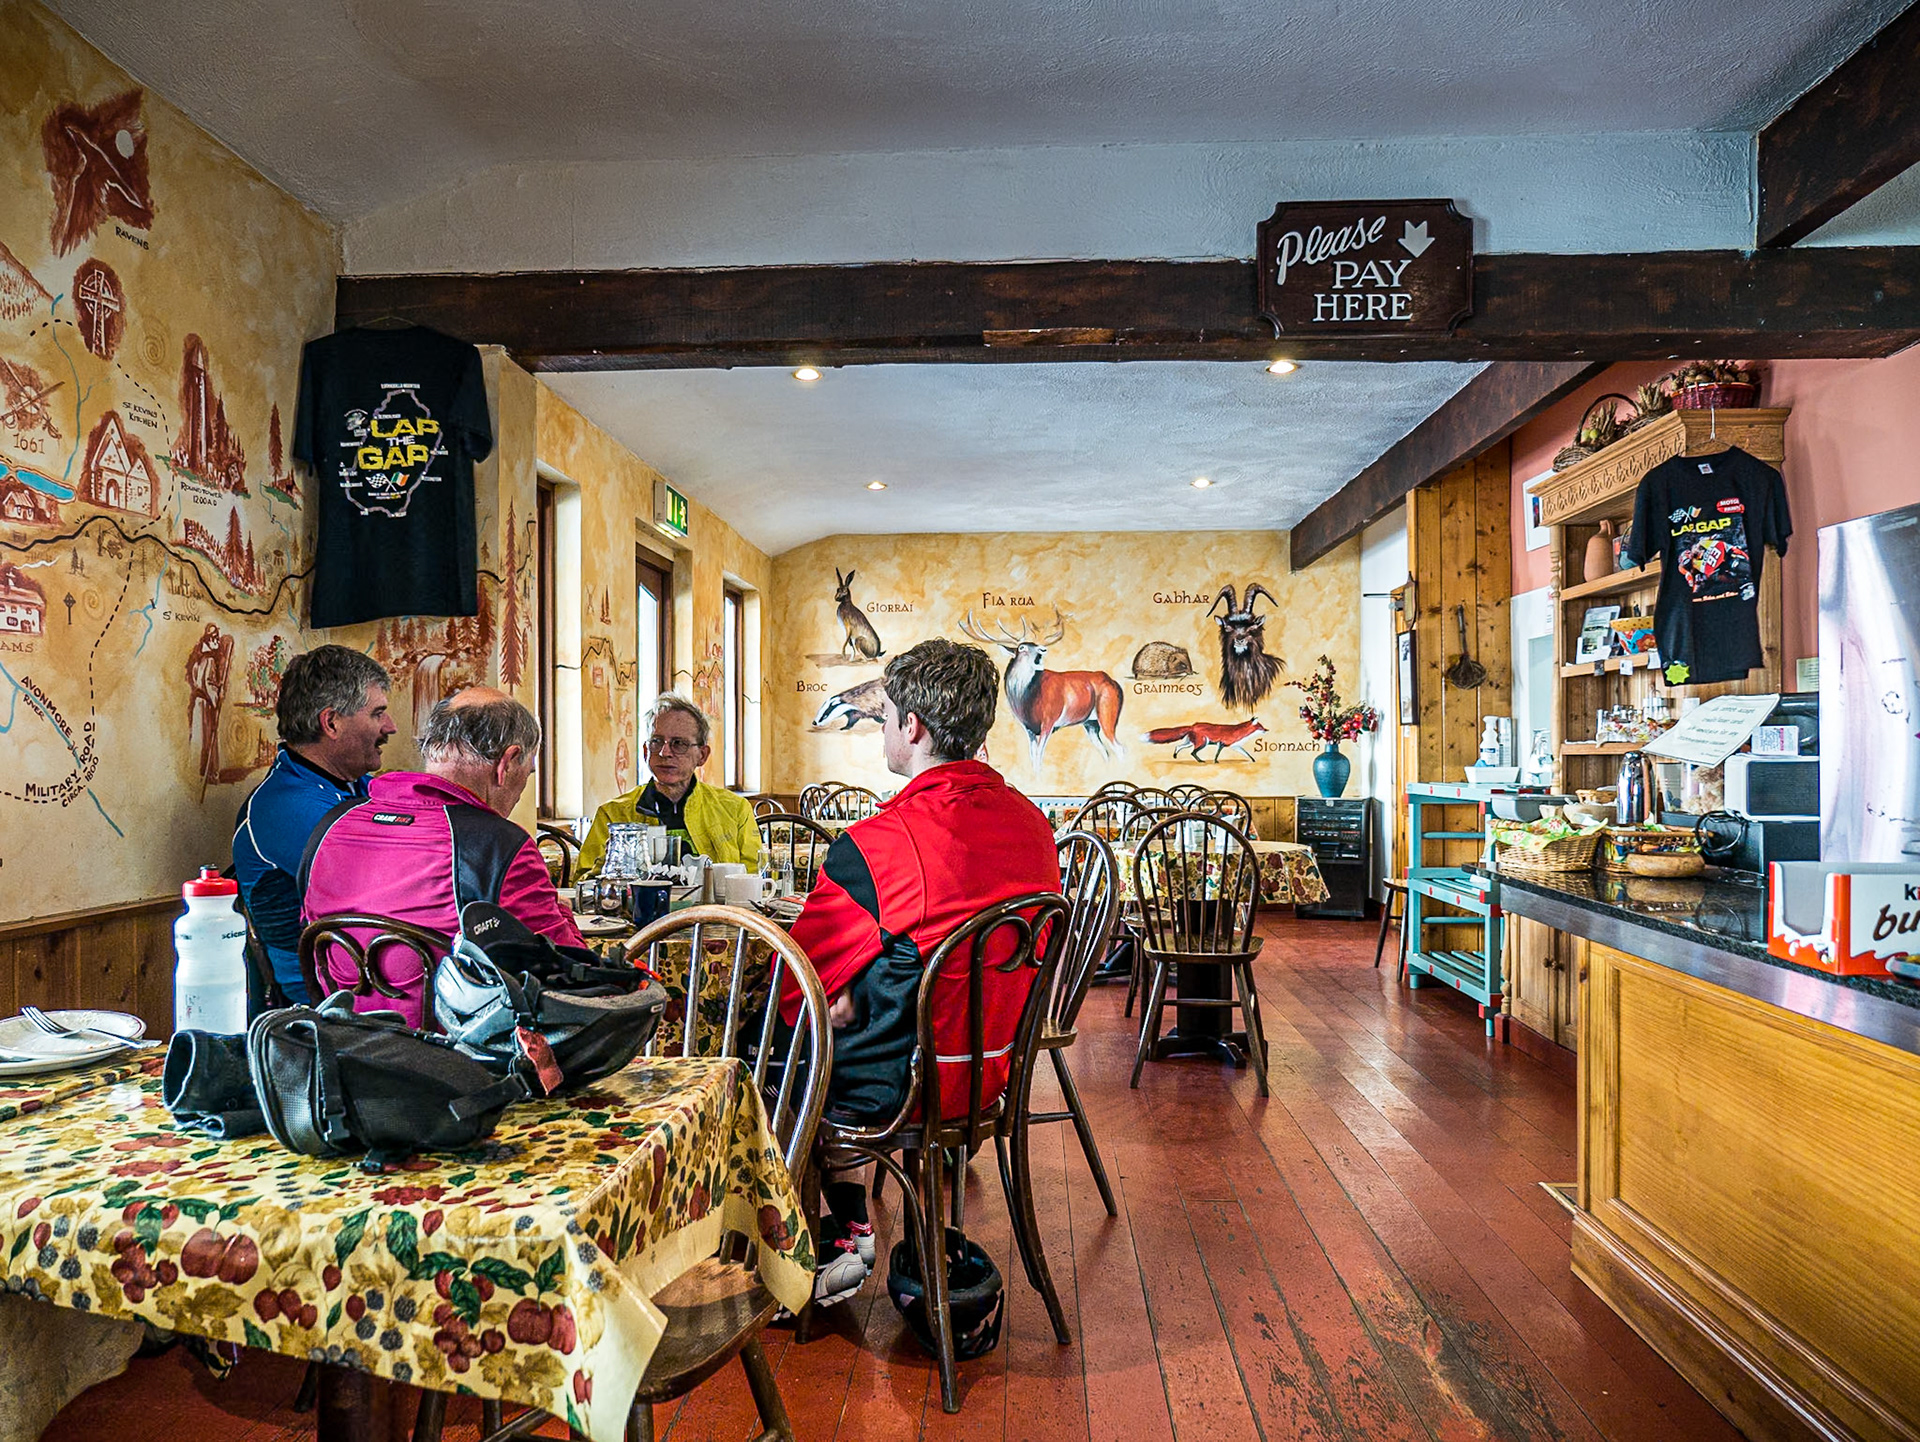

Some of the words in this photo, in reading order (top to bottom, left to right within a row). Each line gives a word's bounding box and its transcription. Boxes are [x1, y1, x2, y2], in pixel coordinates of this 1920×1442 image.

[115, 225, 150, 251] RAVENS
[1276, 215, 1387, 286] Please
[1332, 259, 1412, 289] PAY
[1312, 293, 1413, 322] HERE
[370, 418, 440, 438] LAP
[386, 435, 415, 446] THE
[13, 433, 45, 454] 1661
[357, 444, 429, 470] GAP
[1695, 517, 1732, 534] GAP
[175, 612, 200, 623] KEVIN
[21, 676, 73, 738] AVONMORE
[23, 694, 45, 722] RIVER
[25, 769, 78, 797] MILITARY
[79, 722, 92, 765] ROAD
[85, 756, 99, 782] 1800
[473, 918, 494, 936] CRAFT
